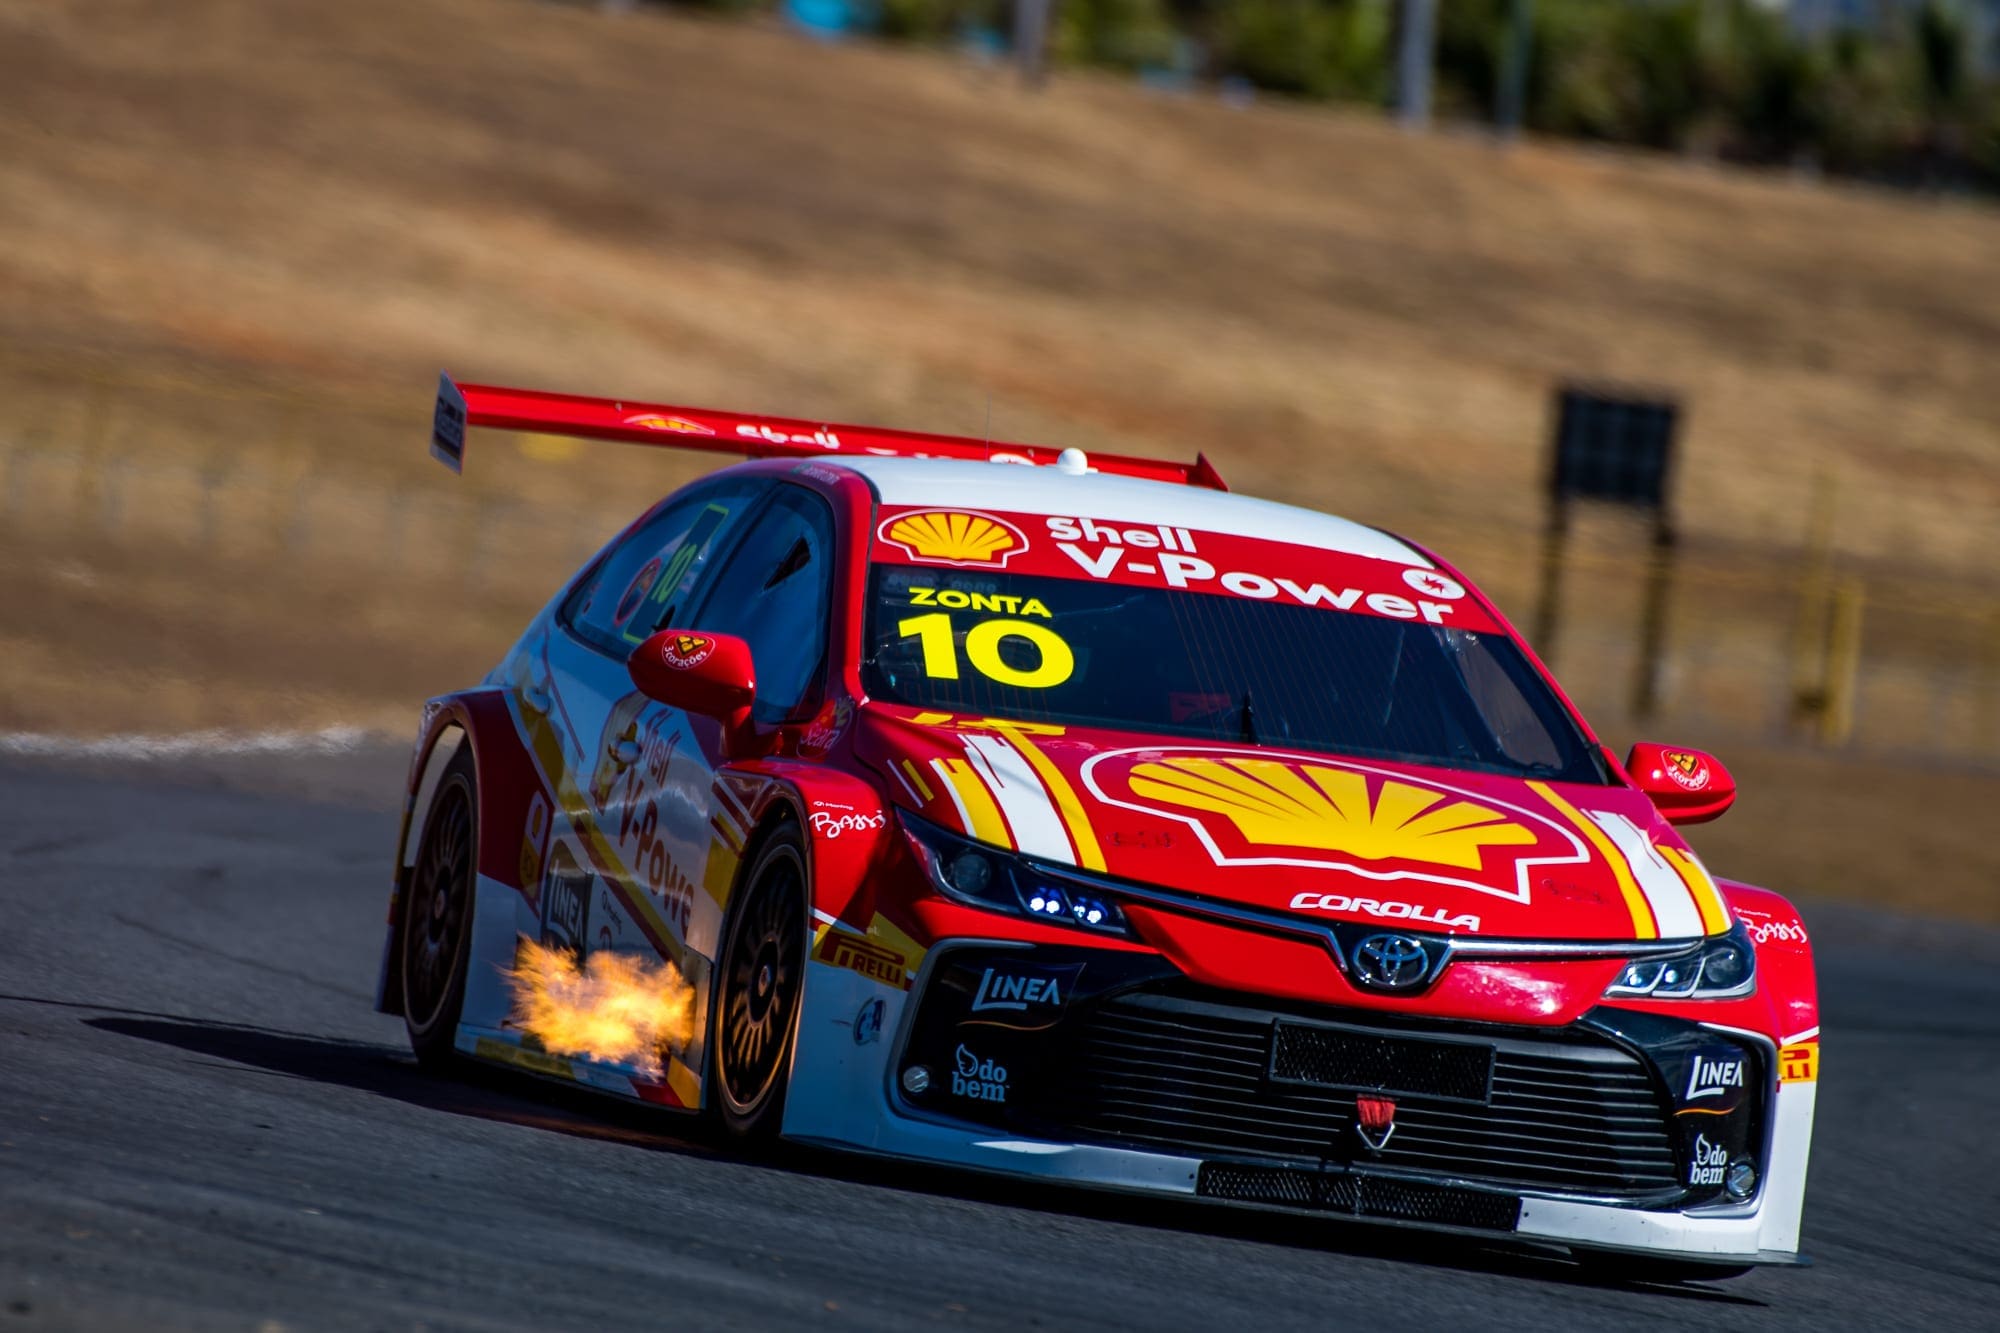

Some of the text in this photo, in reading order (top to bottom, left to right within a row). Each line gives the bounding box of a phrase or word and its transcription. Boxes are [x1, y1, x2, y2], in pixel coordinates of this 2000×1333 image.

[1046, 516, 1197, 554] Shell
[908, 586, 1053, 618] ZONTA
[1056, 542, 1454, 624] V-Power
[898, 612, 1075, 689] 10
[1289, 892, 1480, 932] COROLLA
[819, 930, 906, 985] PIRELLI
[971, 967, 1061, 1012] LINEA
[951, 1070, 1006, 1103] bem
[979, 1058, 1007, 1083] do
[1685, 1055, 1744, 1101] LINEA
[1689, 1161, 1725, 1185] bem
[1709, 1144, 1728, 1167] do
